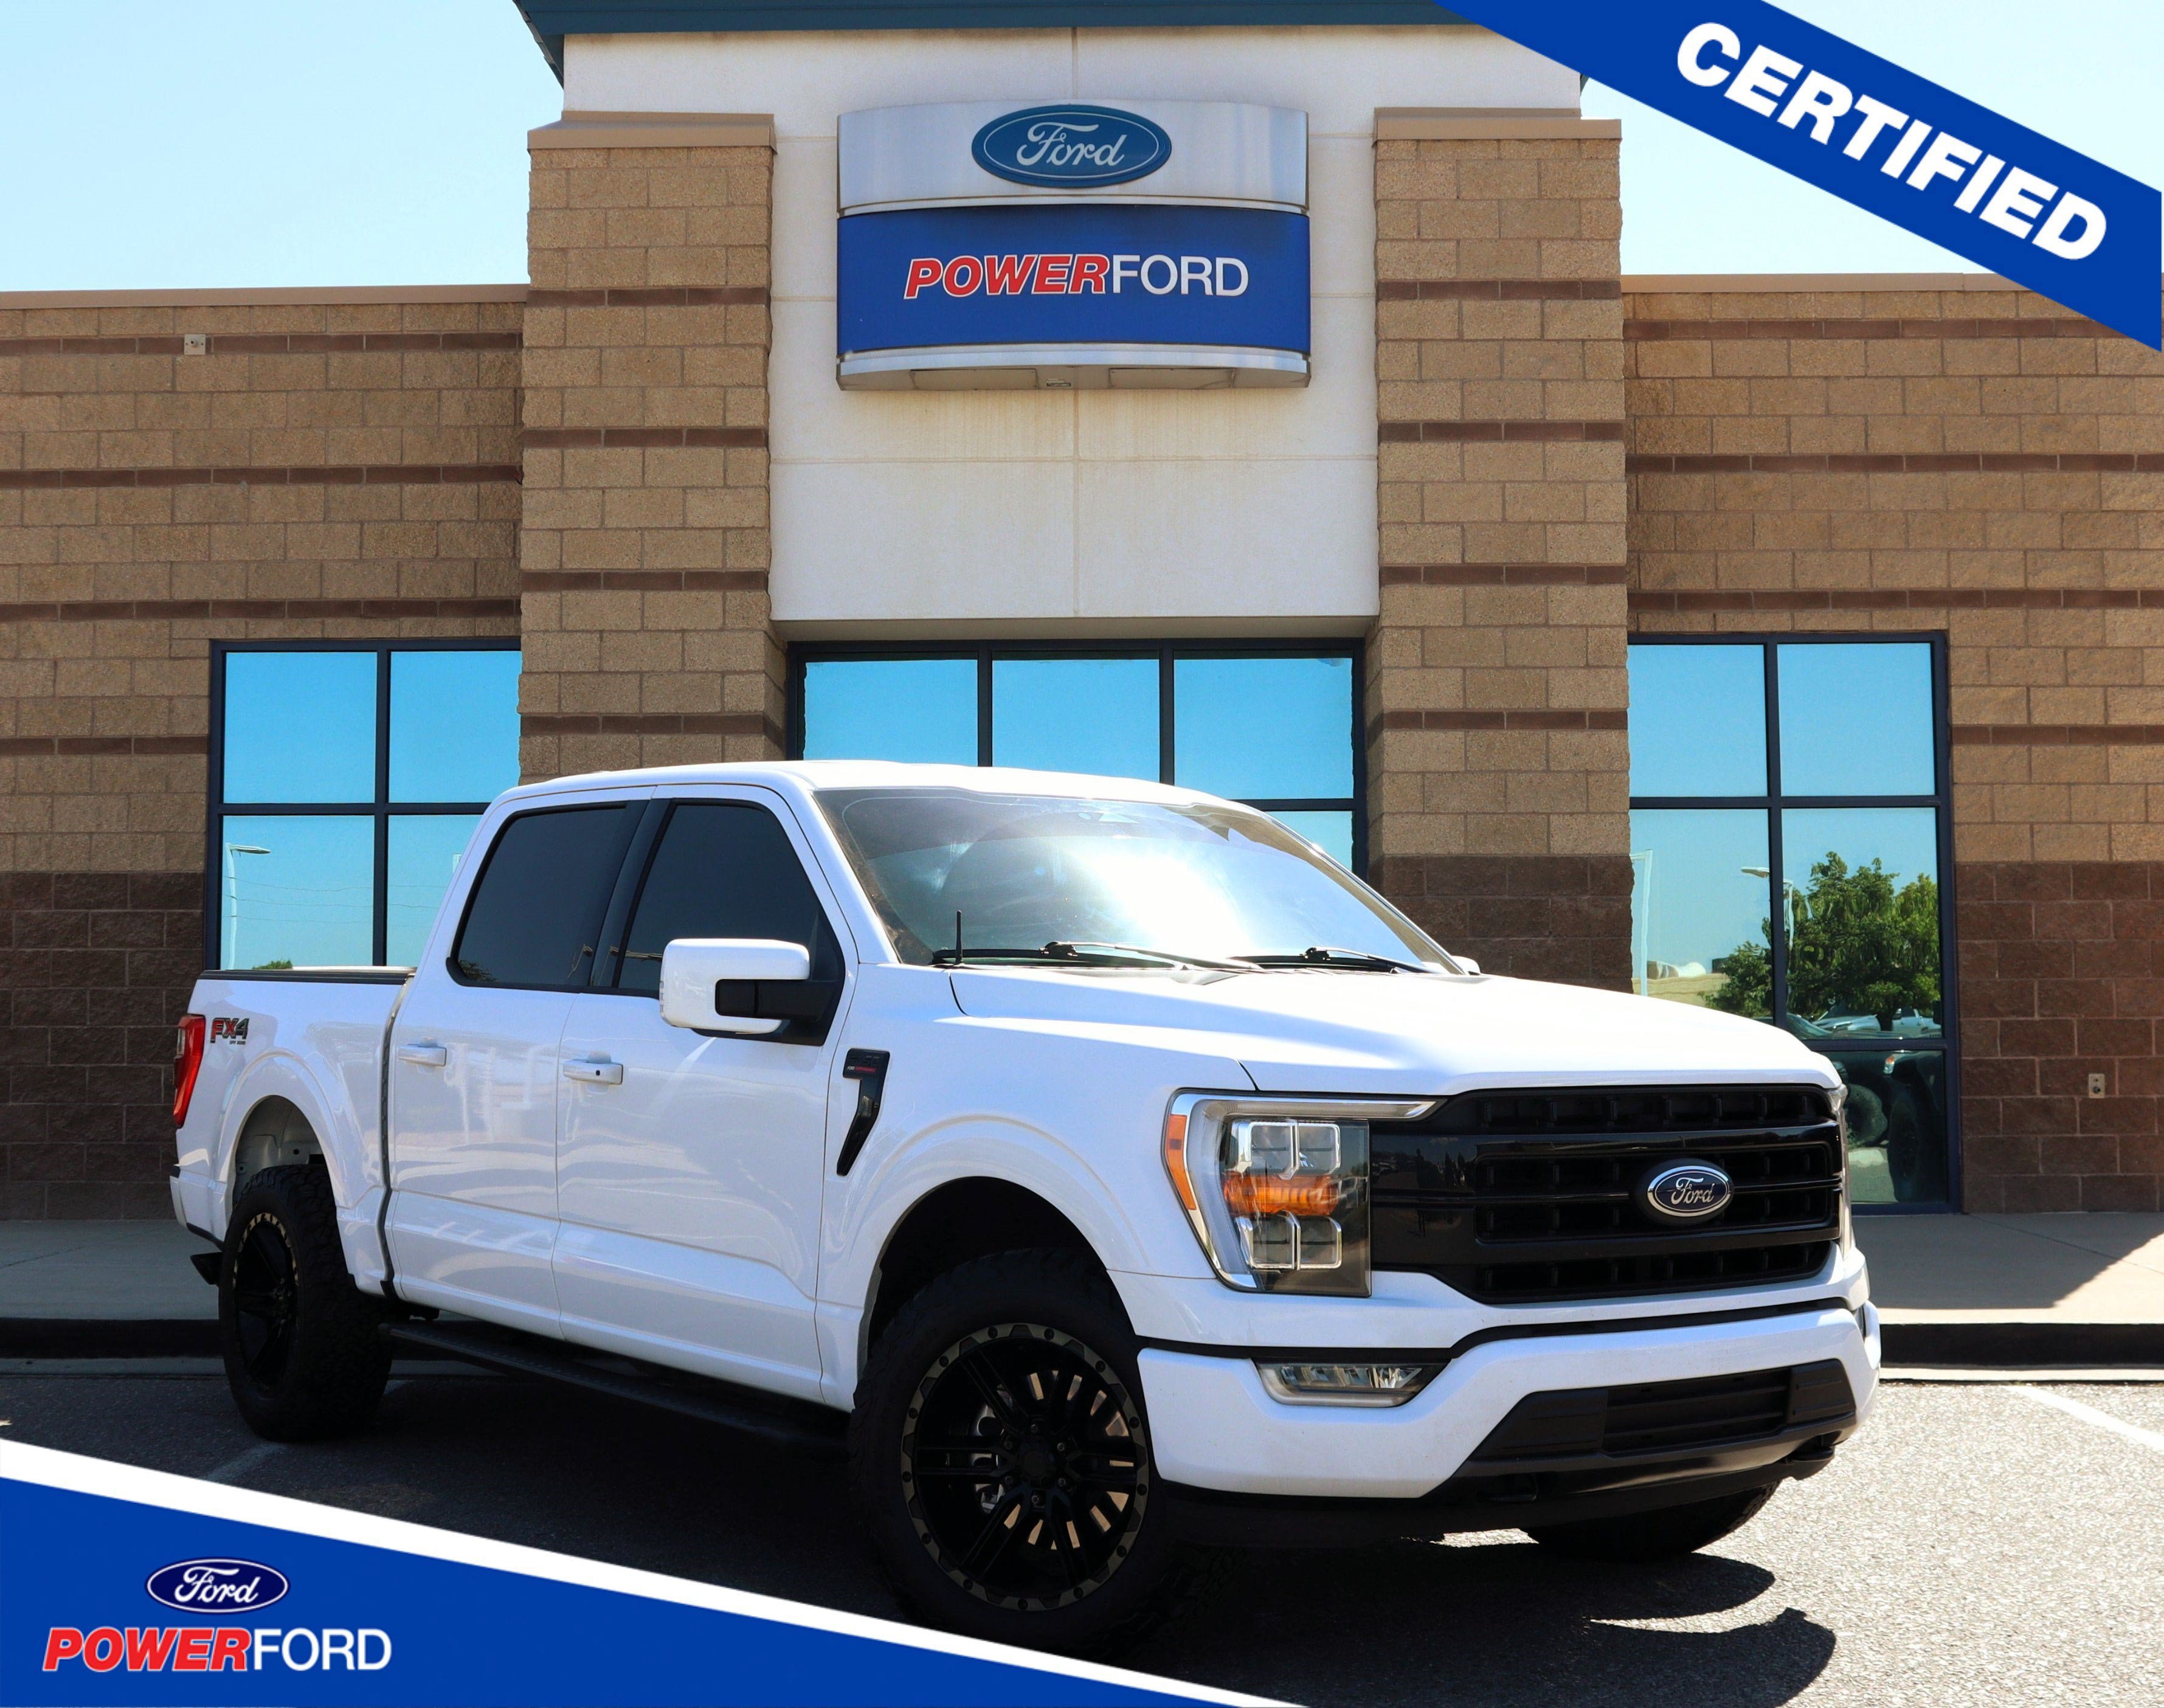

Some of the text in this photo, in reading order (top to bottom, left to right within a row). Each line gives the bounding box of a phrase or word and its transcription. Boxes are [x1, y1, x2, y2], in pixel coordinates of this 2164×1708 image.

[1017, 122, 1127, 166] Ford
[210, 1017, 249, 1043] FX4
[1671, 1177, 1715, 1205] Ford
